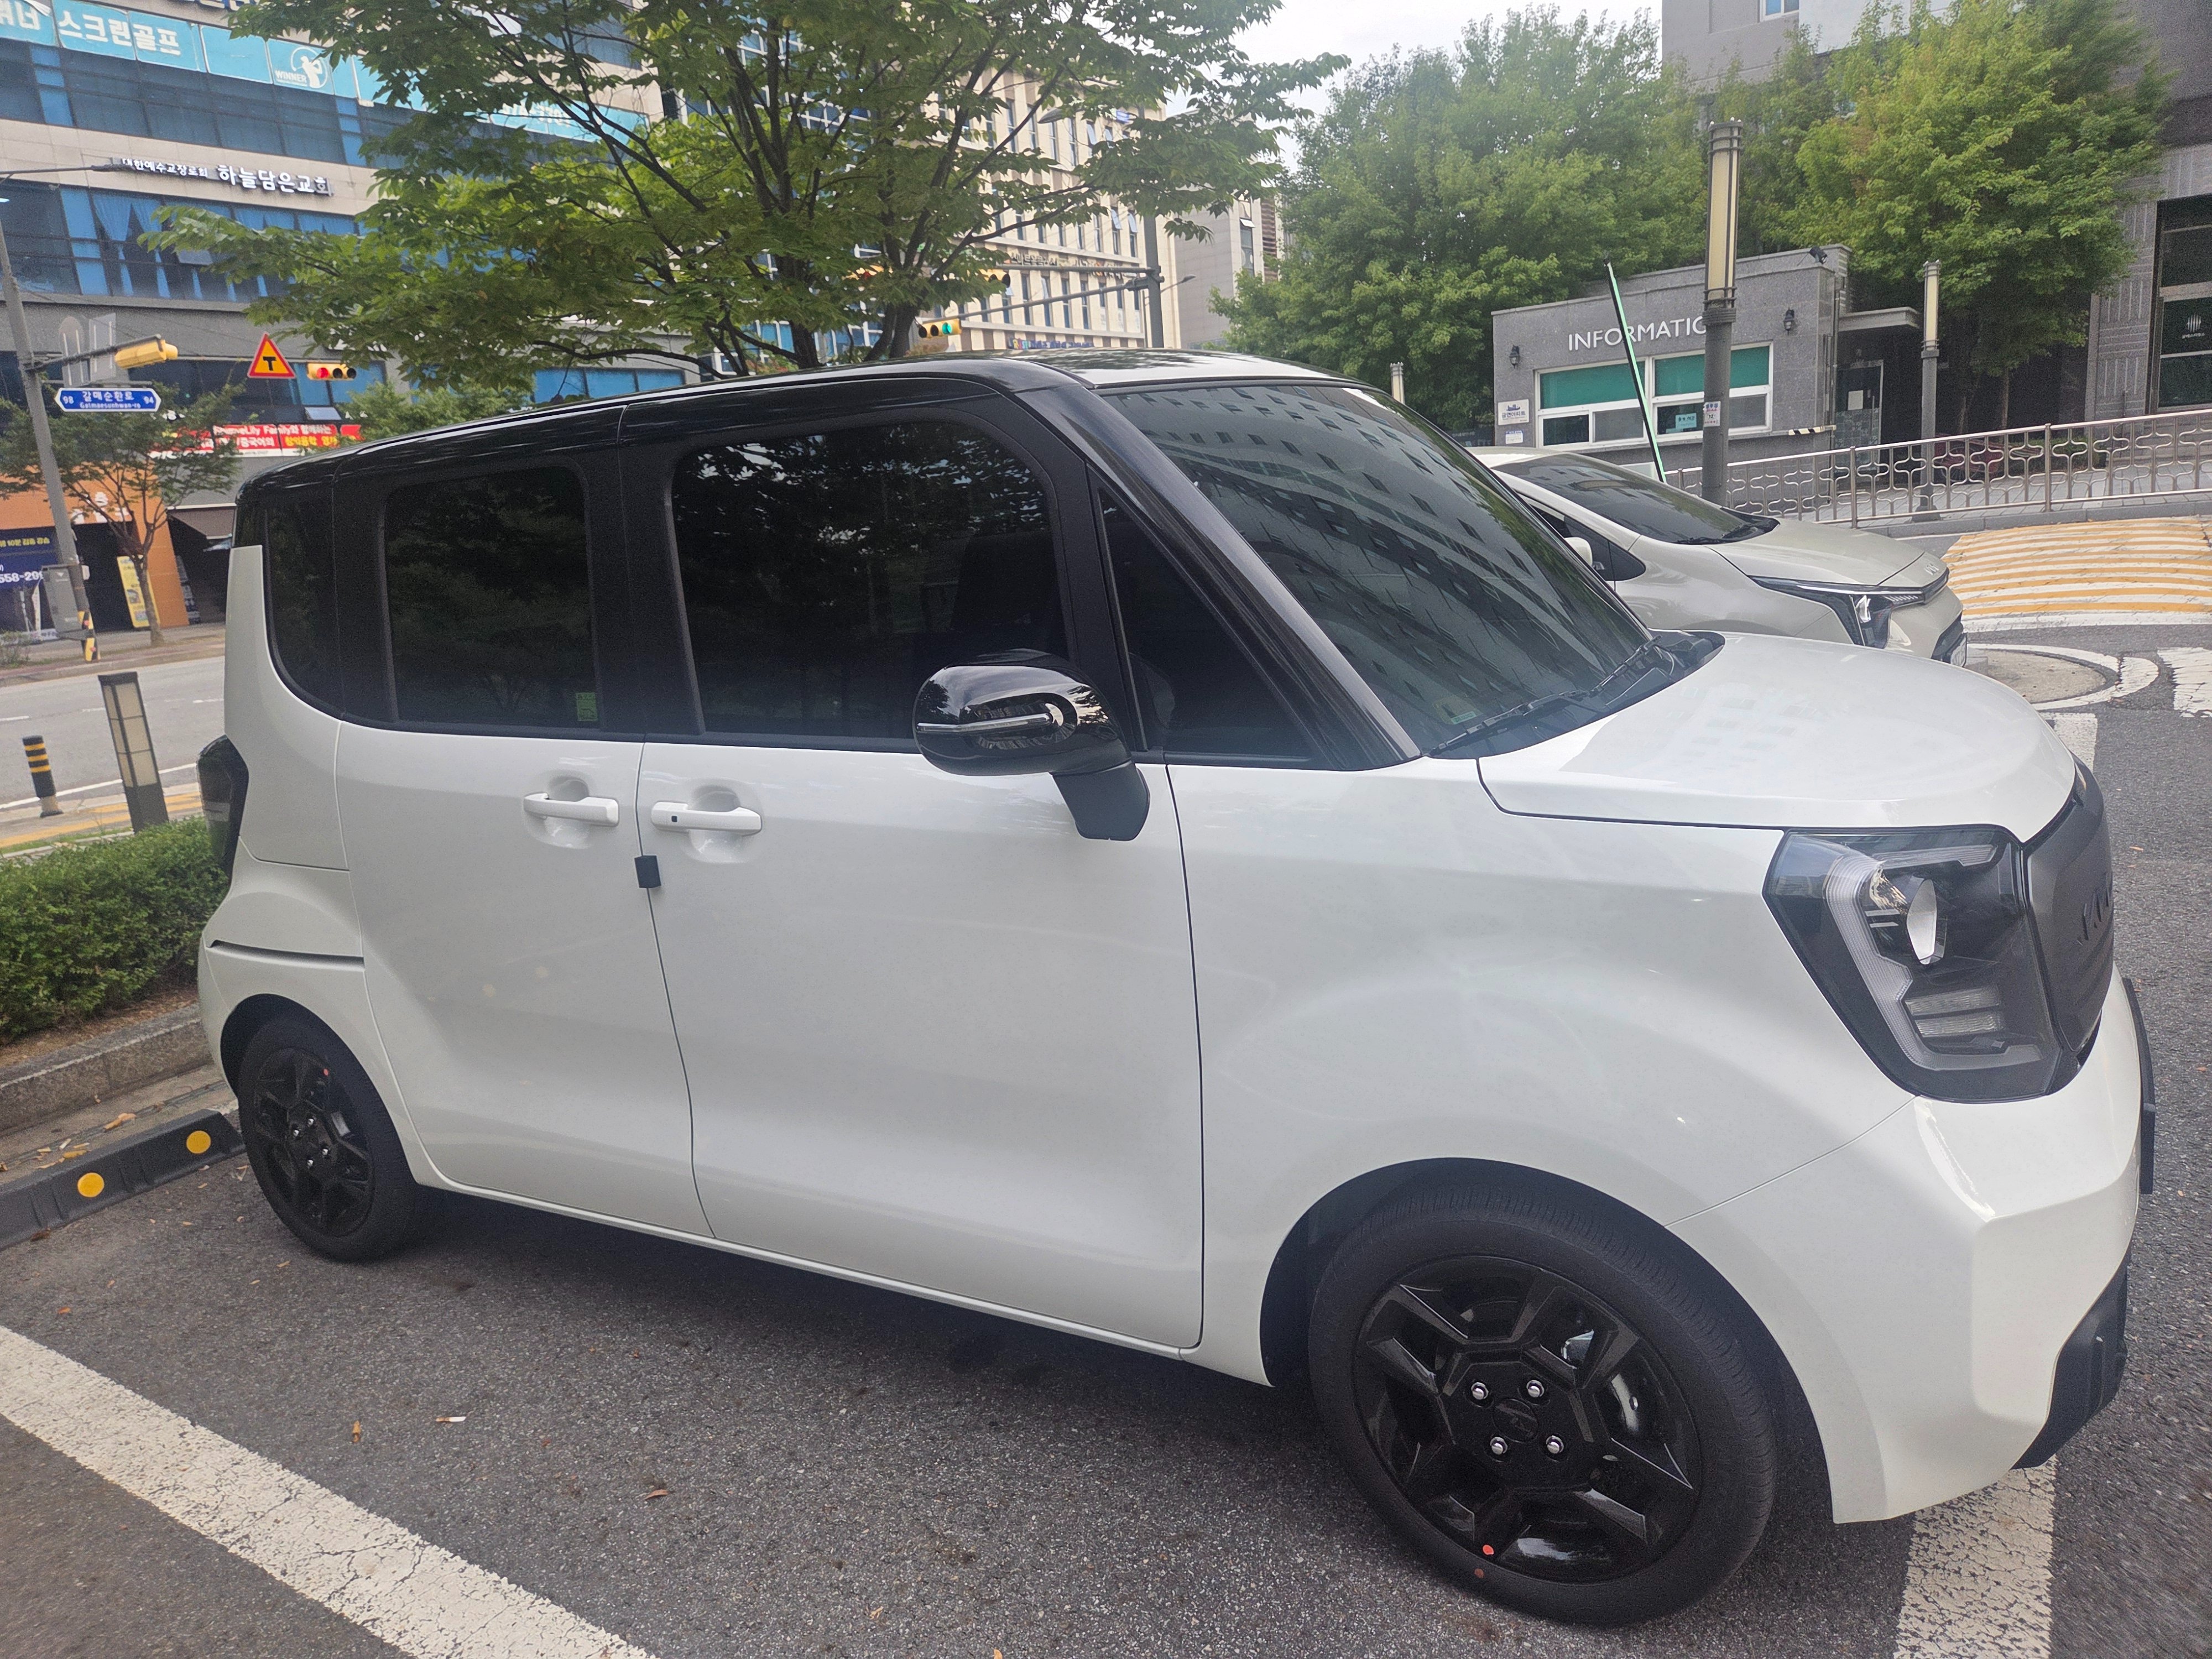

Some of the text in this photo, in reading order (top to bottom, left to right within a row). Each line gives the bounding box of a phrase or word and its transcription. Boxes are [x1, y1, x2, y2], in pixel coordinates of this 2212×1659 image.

[58, 11, 181, 55] 스크린골프
[275, 70, 307, 83] WINNER
[217, 164, 333, 196] 하늘담은교회
[62, 395, 74, 404] 98
[82, 391, 134, 402] 갈매순환로
[143, 396, 154, 404] 94
